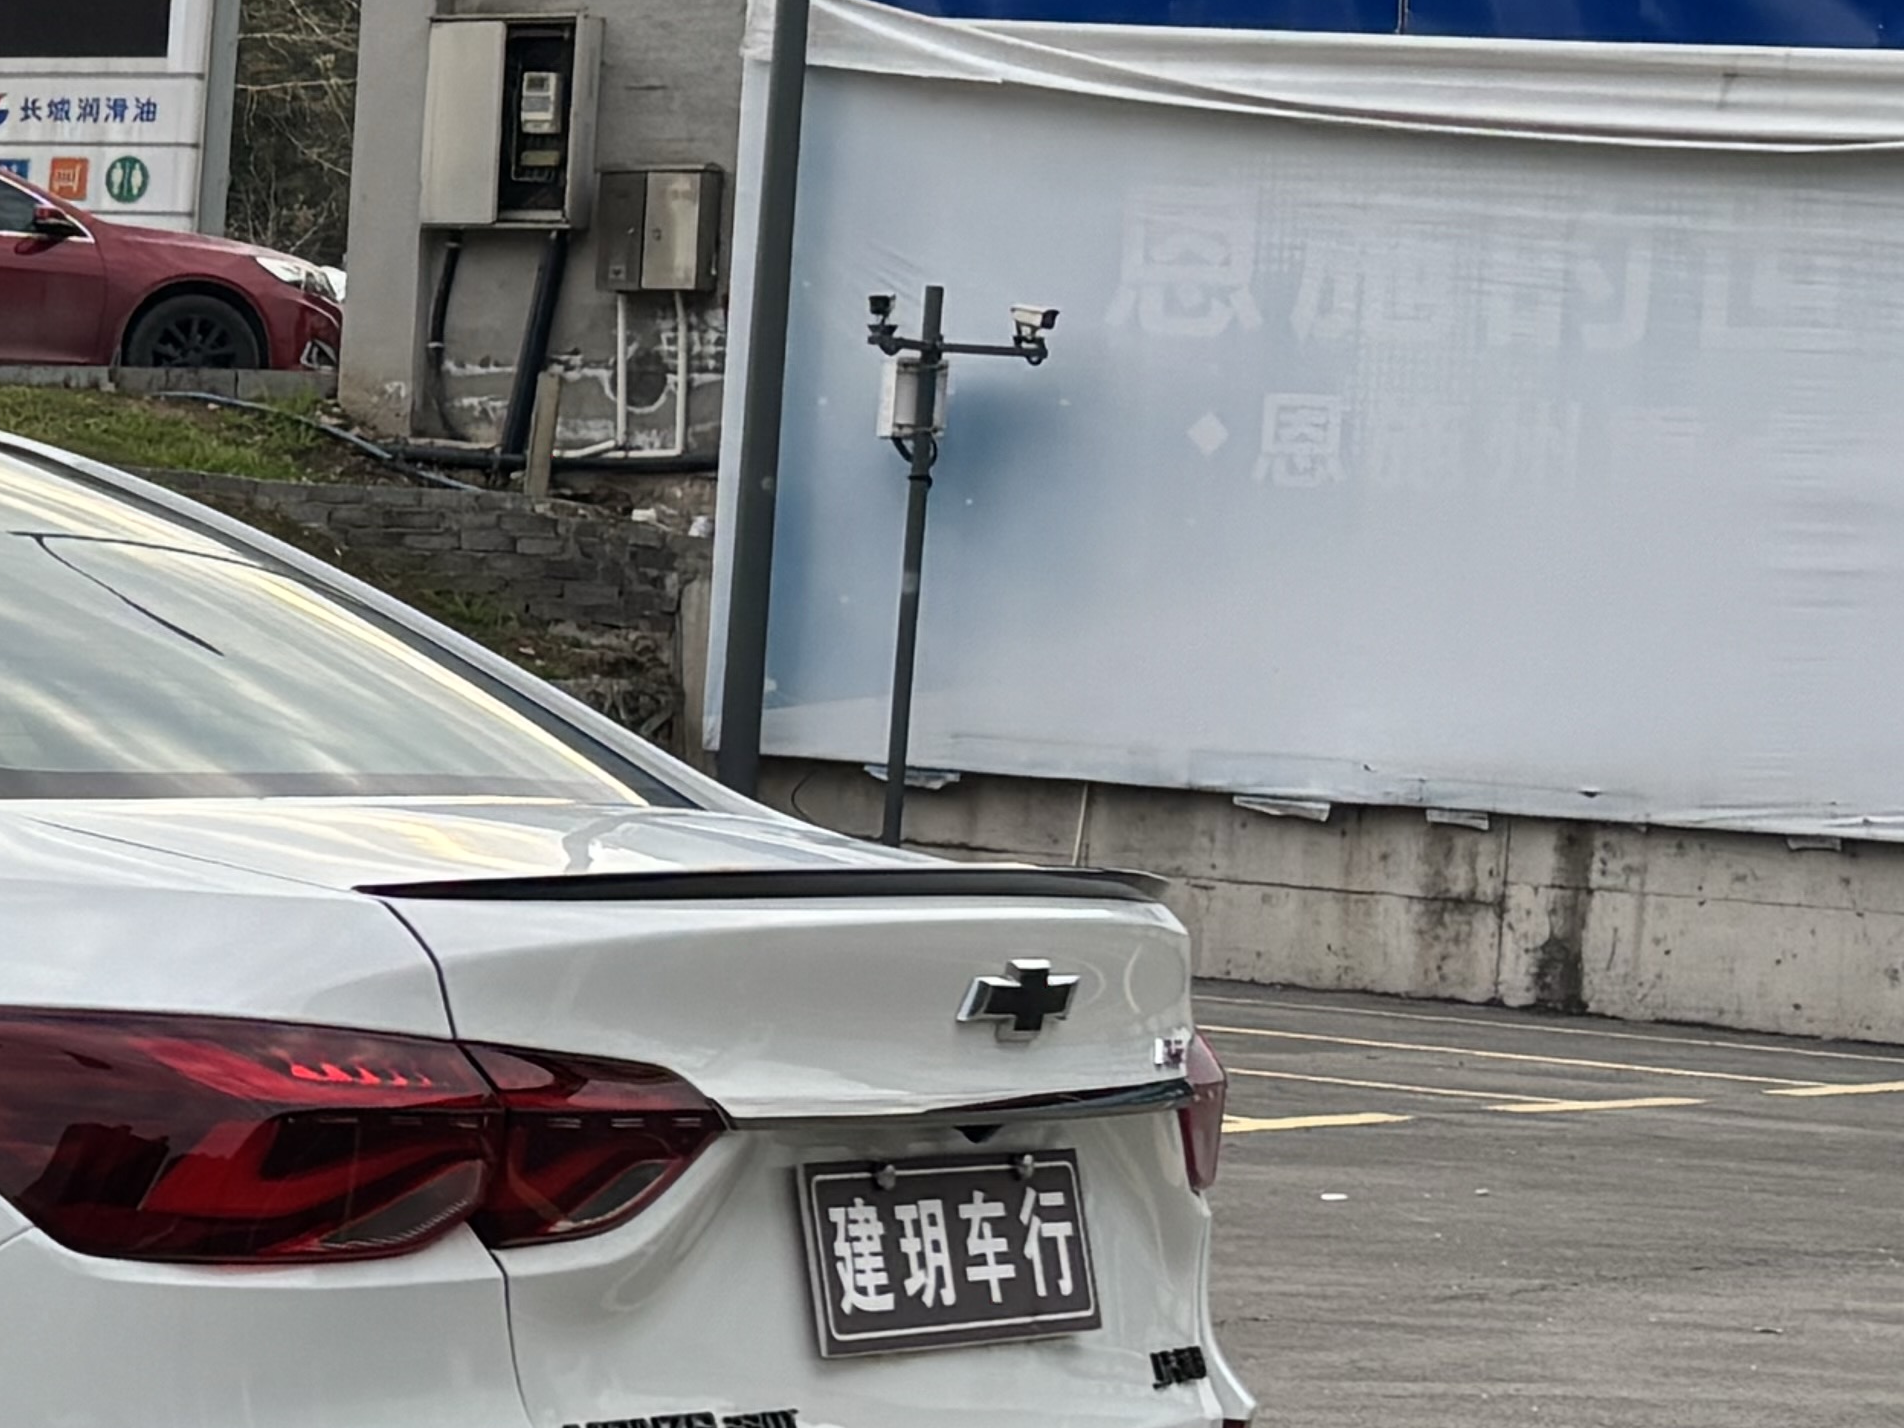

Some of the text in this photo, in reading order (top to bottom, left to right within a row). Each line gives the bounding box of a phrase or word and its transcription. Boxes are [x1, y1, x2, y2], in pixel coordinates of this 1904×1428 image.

[19, 96, 158, 123] 长城润滑油
[828, 1186, 1076, 1315] 建玥车行
